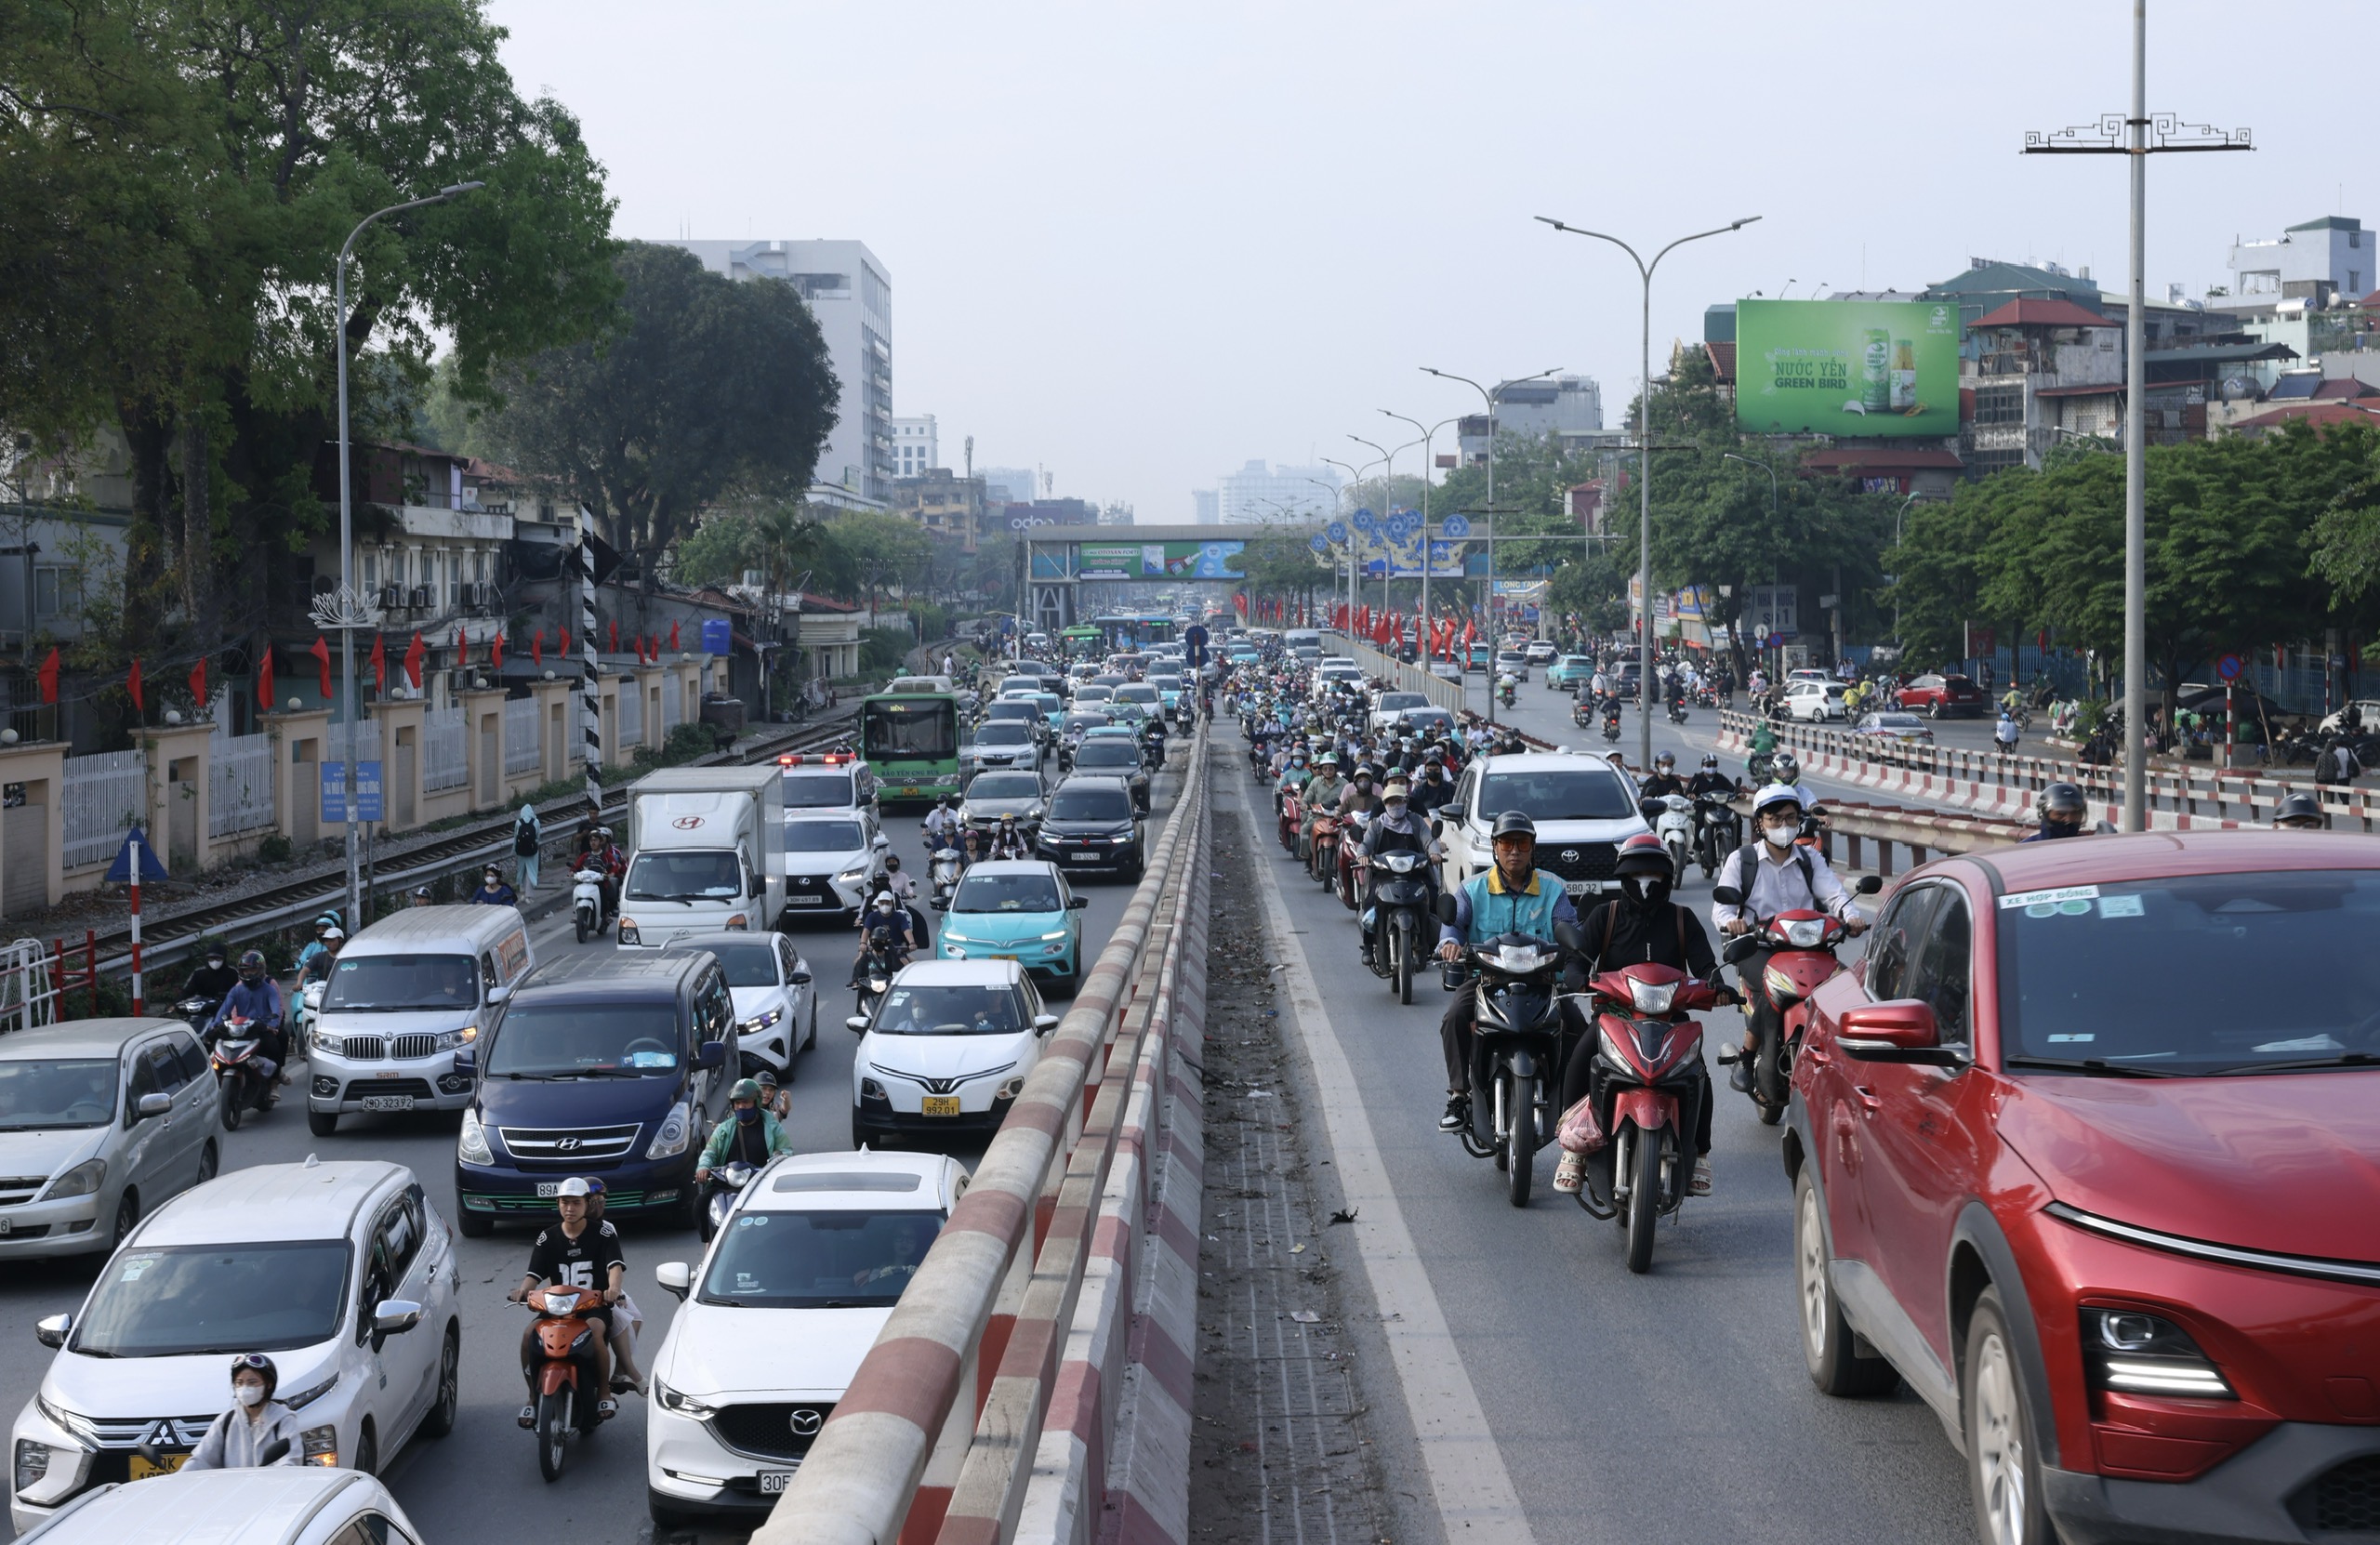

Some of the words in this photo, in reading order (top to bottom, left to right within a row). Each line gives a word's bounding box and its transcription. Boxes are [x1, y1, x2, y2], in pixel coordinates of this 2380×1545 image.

[1776, 359, 1813, 376] NƯỚC
[1820, 357, 1847, 376] YẾN
[1775, 377, 1815, 388] GREEN
[1818, 378, 1846, 389] BIRD
[1500, 580, 1521, 588] LONG
[2006, 896, 2022, 905] XE
[2027, 892, 2053, 904] HỢP
[933, 1098, 949, 1106] 29H
[601, 1401, 608, 1409] G
[523, 1407, 531, 1417] G
